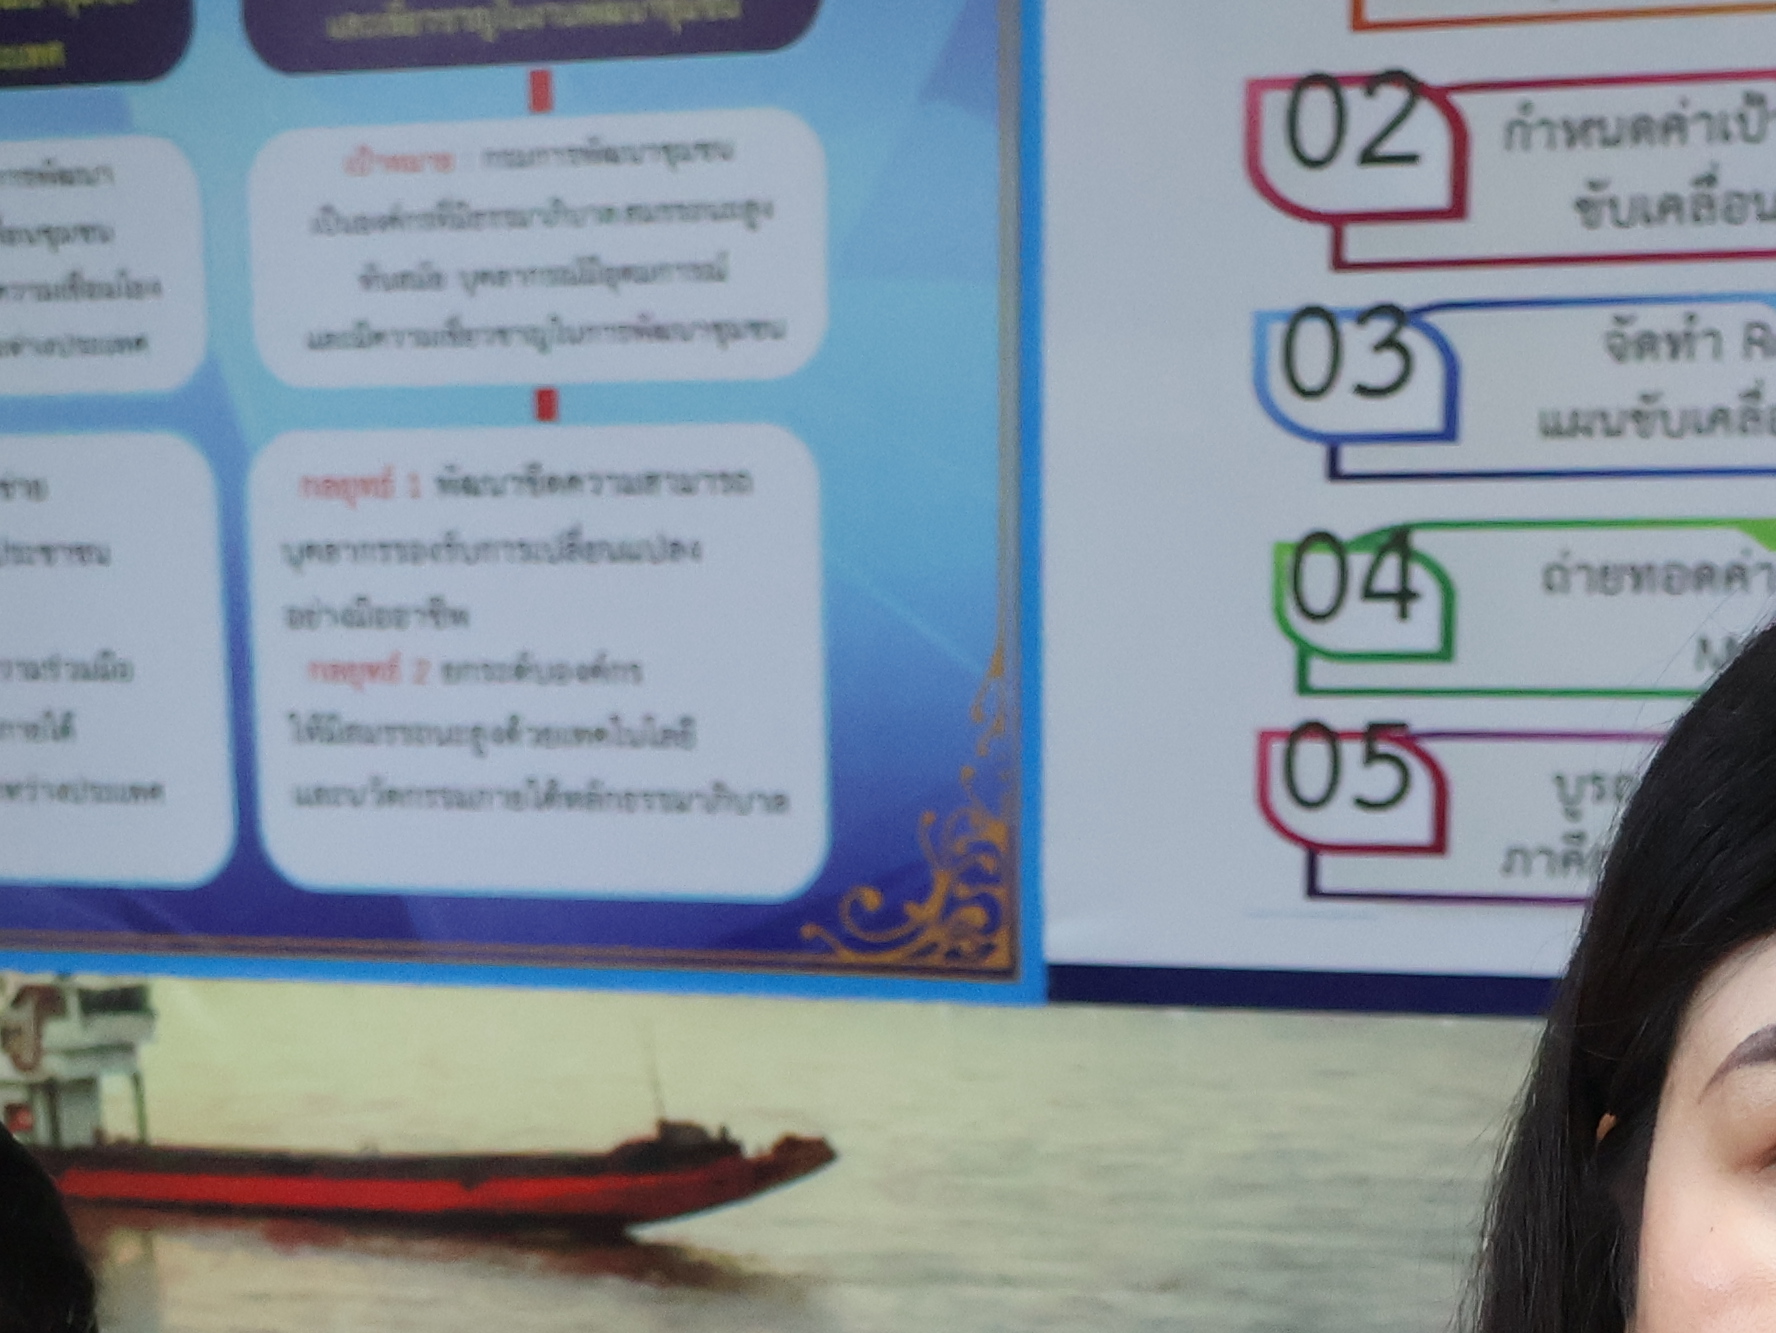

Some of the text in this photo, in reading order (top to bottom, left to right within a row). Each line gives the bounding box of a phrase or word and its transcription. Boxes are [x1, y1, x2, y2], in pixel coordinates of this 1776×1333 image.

[1284, 68, 1424, 172] 02
[1280, 304, 1416, 400] 03
[1290, 530, 1420, 622] 04
[1284, 722, 1414, 810] 05
